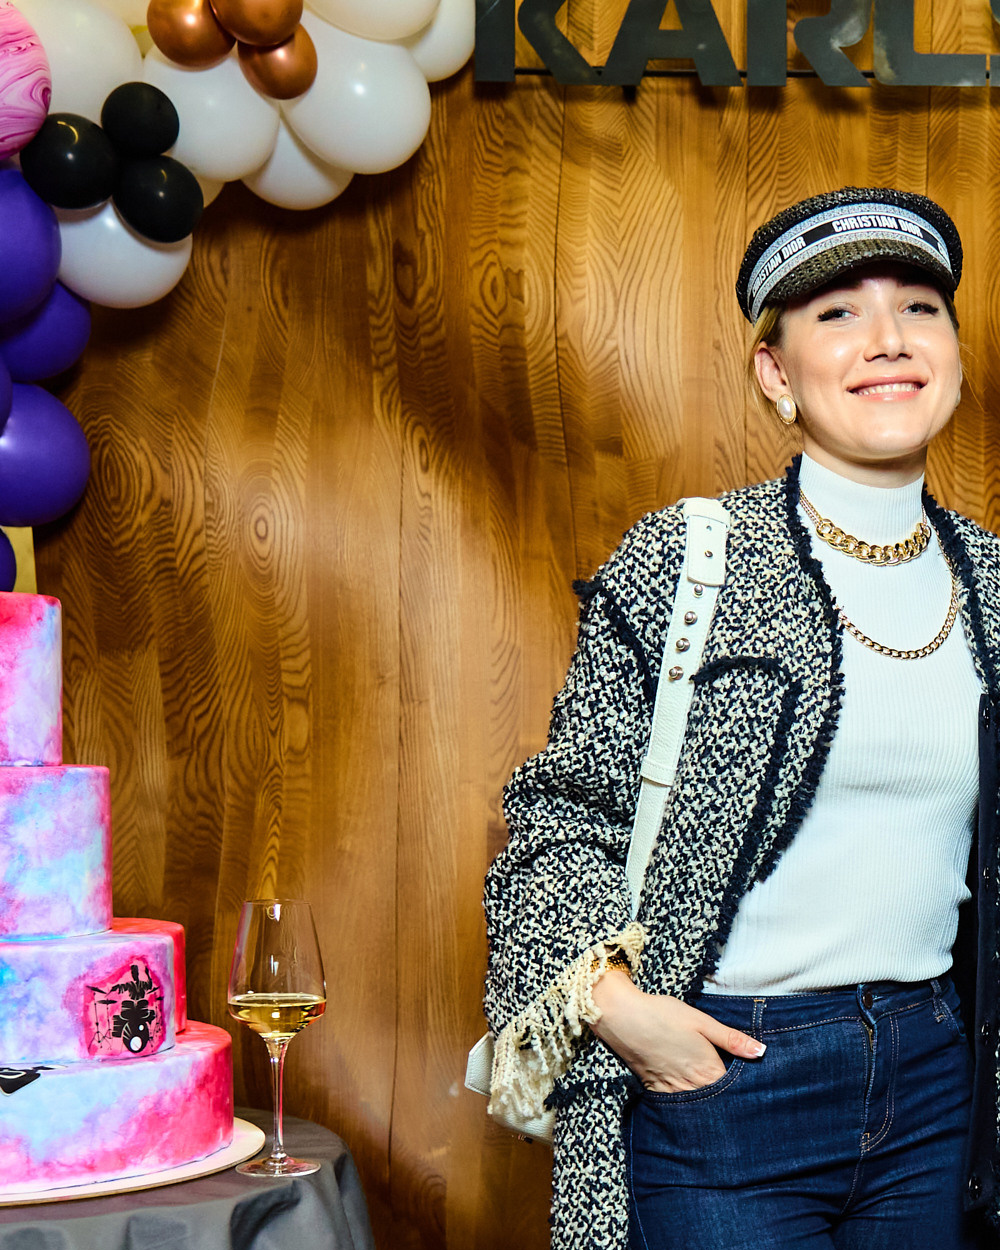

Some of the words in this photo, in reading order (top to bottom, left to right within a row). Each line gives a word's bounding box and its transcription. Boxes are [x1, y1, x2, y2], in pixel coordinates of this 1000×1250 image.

[831, 215, 899, 233] CHRISTIAN
[898, 219, 924, 239] DIOR
[781, 236, 806, 260] DIOR
